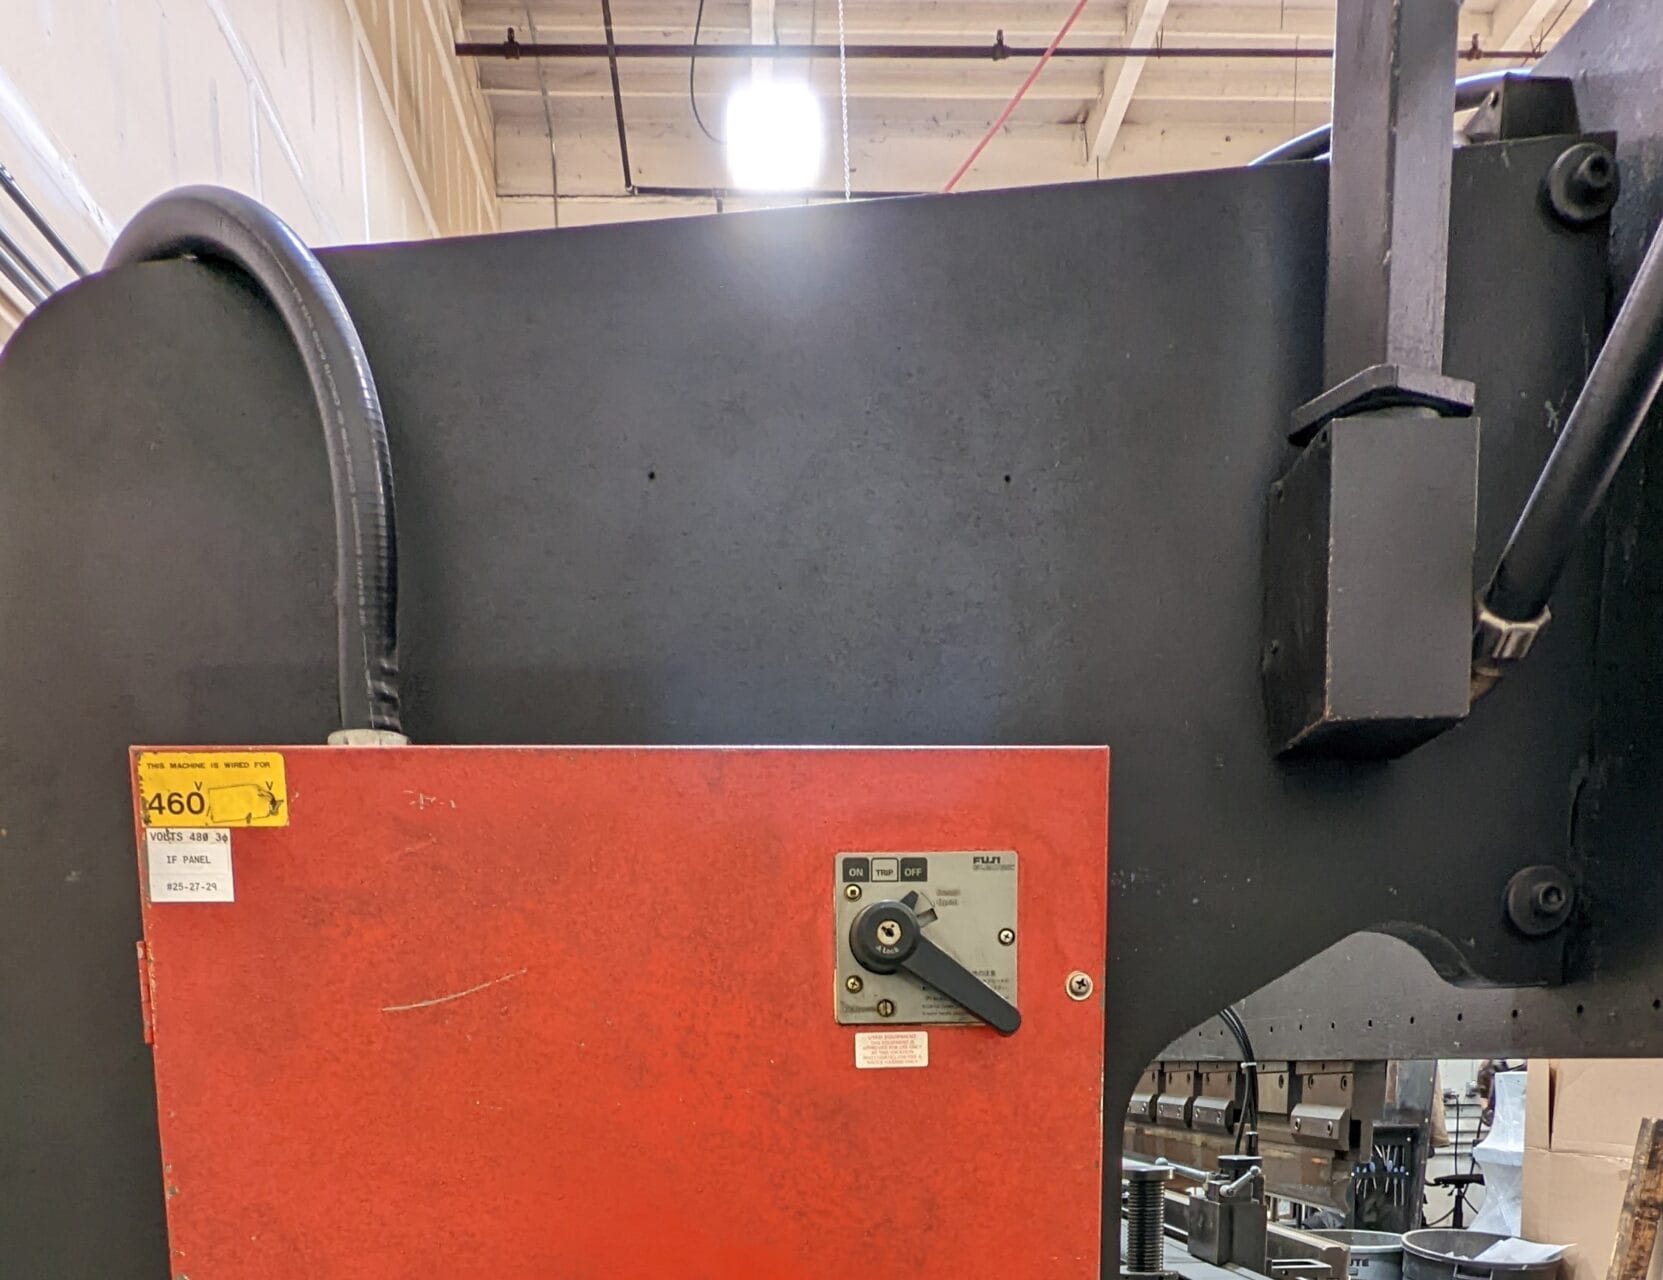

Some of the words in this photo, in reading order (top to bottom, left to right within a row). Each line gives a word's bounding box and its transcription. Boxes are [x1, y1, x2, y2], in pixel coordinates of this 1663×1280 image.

[210, 761, 219, 769] IS
[148, 792, 205, 815] 460
[150, 832, 183, 841] VOLTS
[189, 832, 209, 842] 480
[166, 855, 177, 864] IF
[183, 855, 212, 864] PANEL
[972, 855, 1001, 864] FUJI
[849, 868, 864, 877] ON
[875, 869, 894, 877] TRIP
[904, 867, 923, 877] OFF
